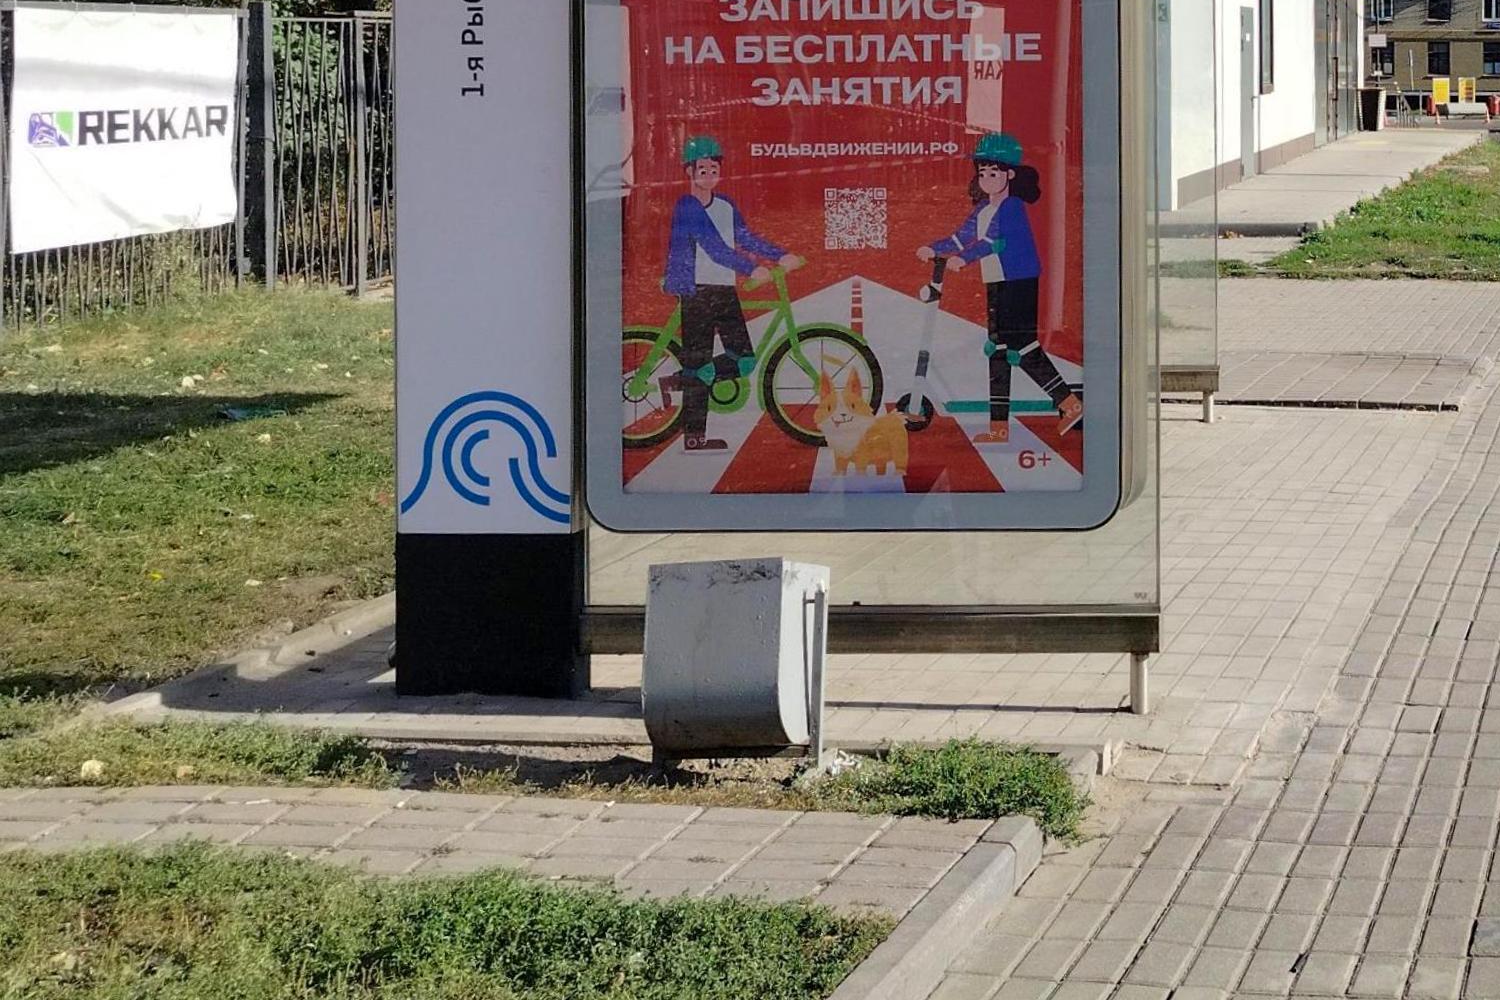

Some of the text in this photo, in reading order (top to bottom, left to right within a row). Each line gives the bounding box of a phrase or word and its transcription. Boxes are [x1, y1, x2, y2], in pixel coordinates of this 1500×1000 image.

[666, 34, 1042, 64] НА БЕСПЛАТНЫЕ
[461, 55, 485, 97] 1-я
[751, 76, 962, 107] ЗАНЯТИЯ
[78, 105, 228, 146] REKKAR
[750, 141, 959, 158] БУДЬВДВИЖЕНИИ.РФ
[1018, 449, 1052, 469] 6+
